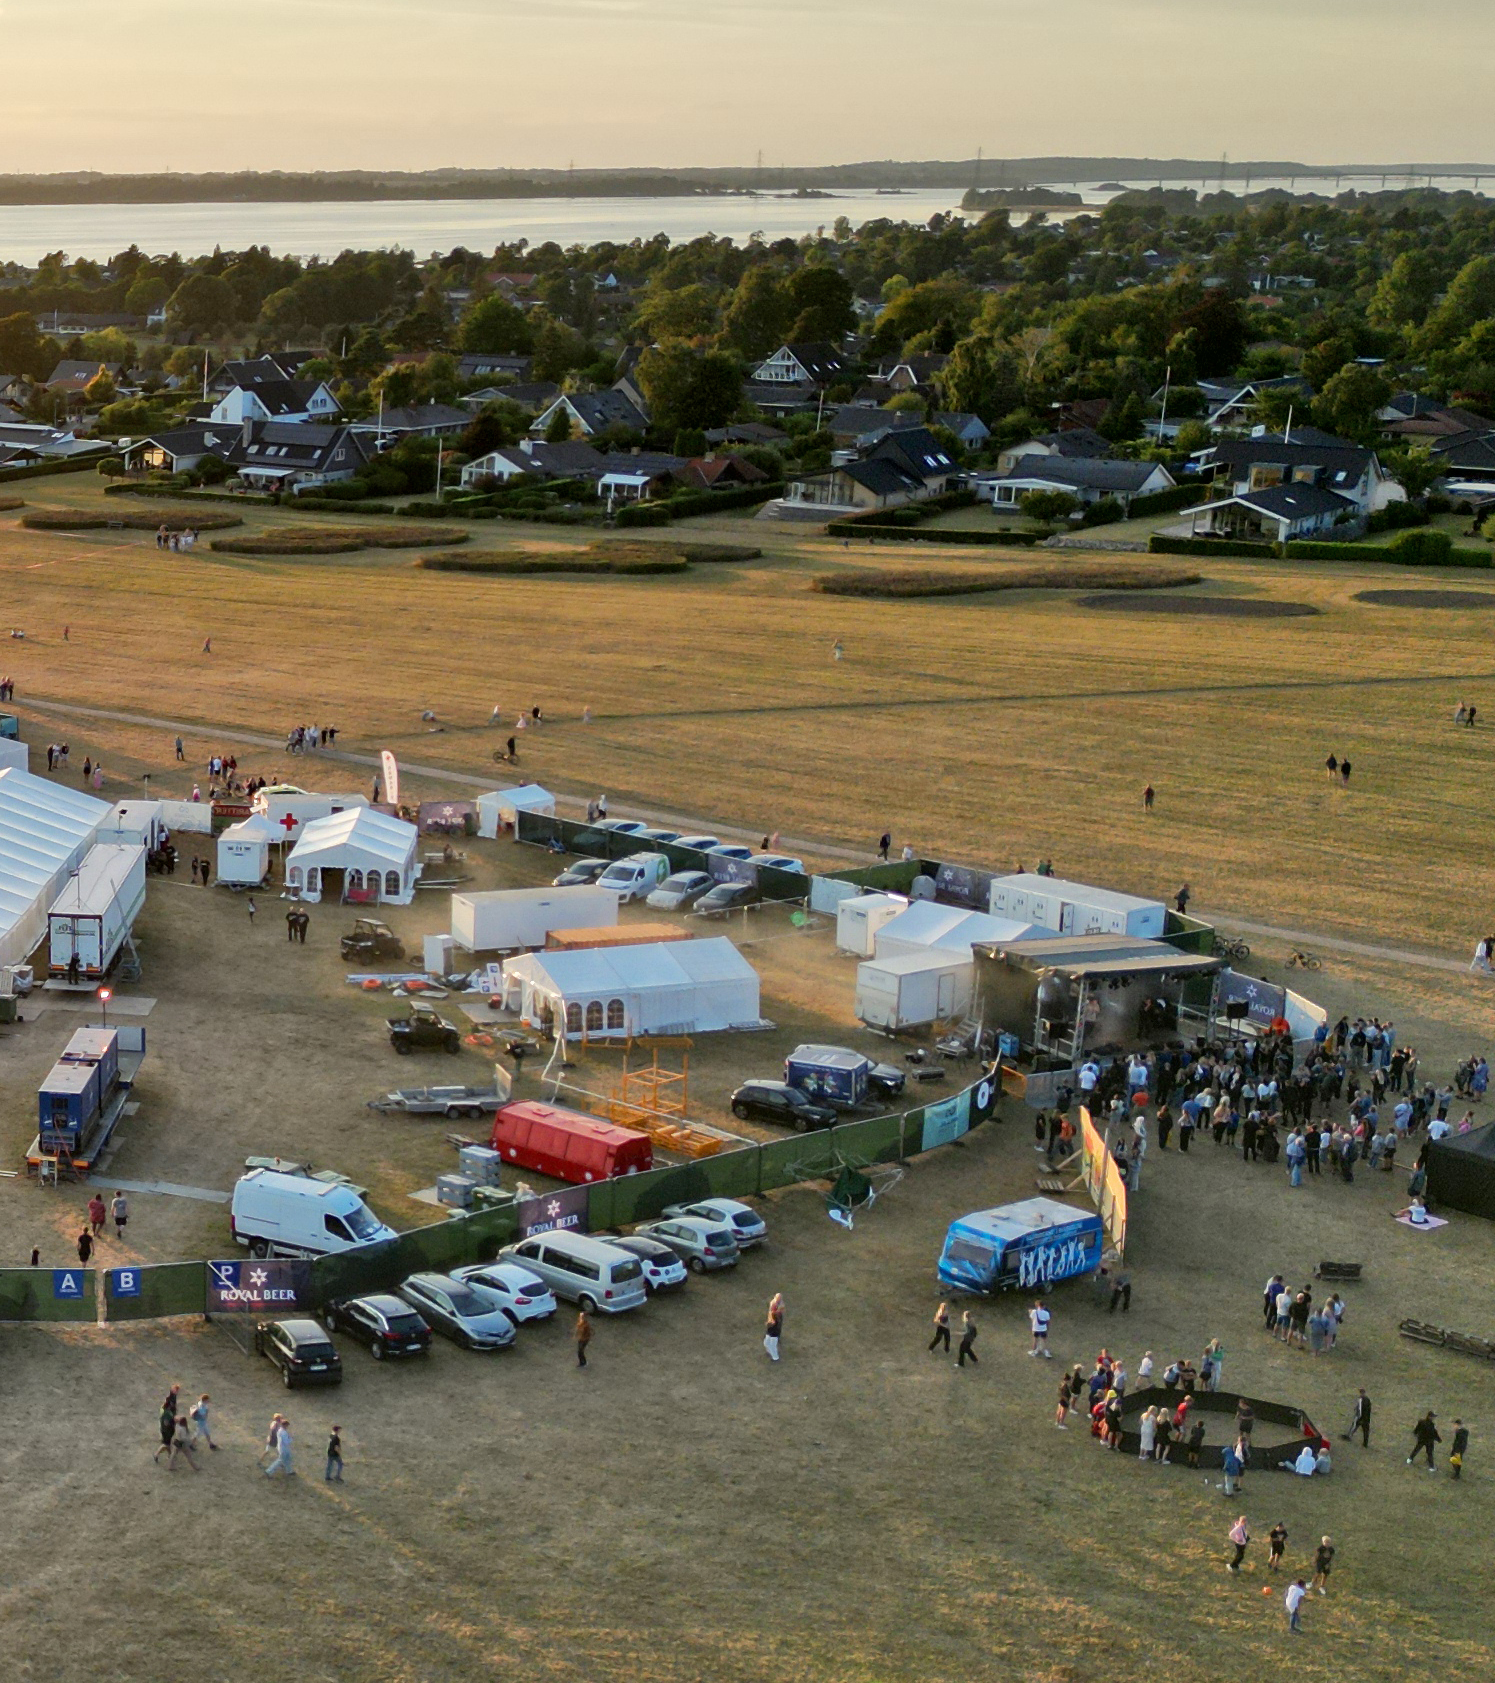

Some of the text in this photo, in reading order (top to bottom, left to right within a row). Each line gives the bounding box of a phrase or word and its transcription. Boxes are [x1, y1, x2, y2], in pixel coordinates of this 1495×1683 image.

[526, 1214, 579, 1237] ROYAL BEER
[61, 1273, 76, 1289] A
[120, 1272, 134, 1288] B
[220, 1290, 297, 1302] ROYAL BEER
